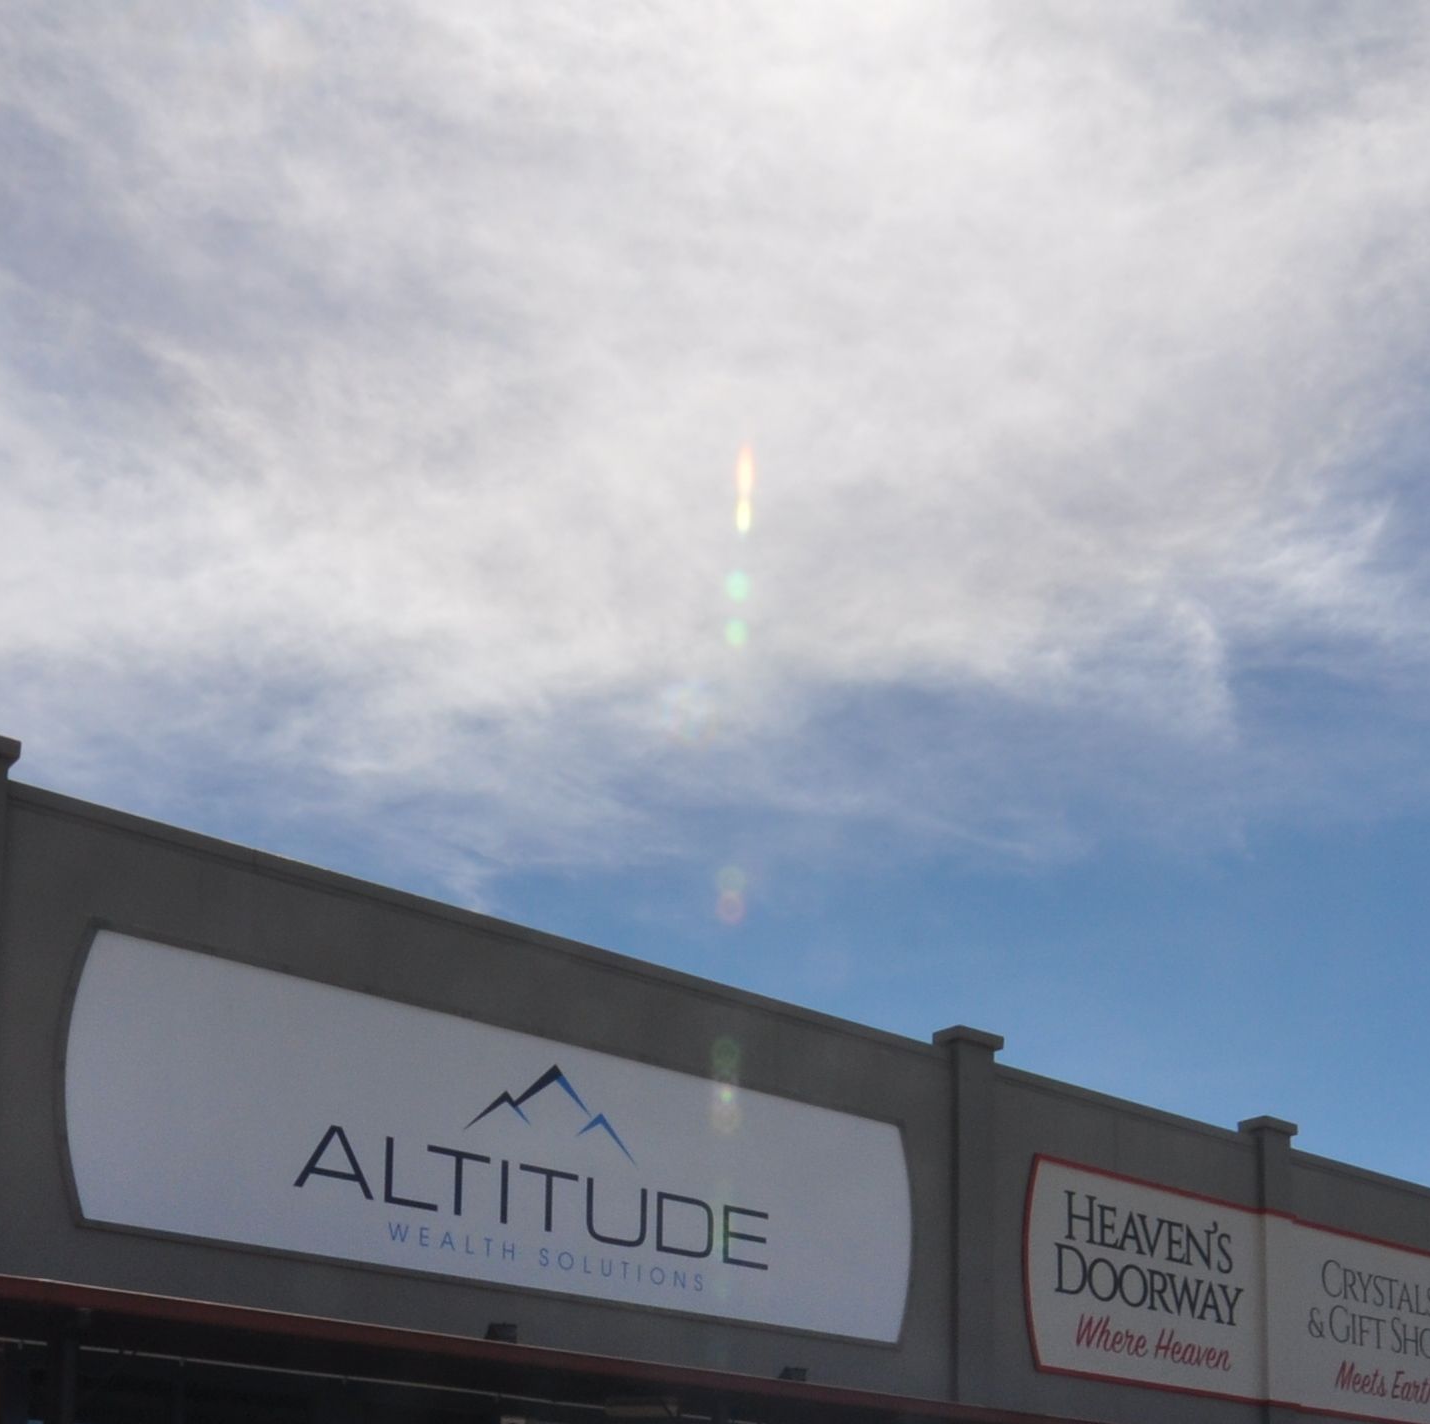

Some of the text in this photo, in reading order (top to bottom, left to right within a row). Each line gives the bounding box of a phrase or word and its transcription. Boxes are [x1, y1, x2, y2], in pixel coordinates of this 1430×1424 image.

[294, 1125, 769, 1271] ALTITUDE
[1063, 1190, 1233, 1273] HEAVEN'S
[388, 1221, 705, 1292] WEALTH SOLUTIONS
[1054, 1242, 1244, 1326] DOORWAY
[1076, 1314, 1231, 1372] Where Heaven
[1307, 1308, 1324, 1339] &
[1329, 1305, 1387, 1350] GIFT
[1335, 1360, 1387, 1397] Meets
